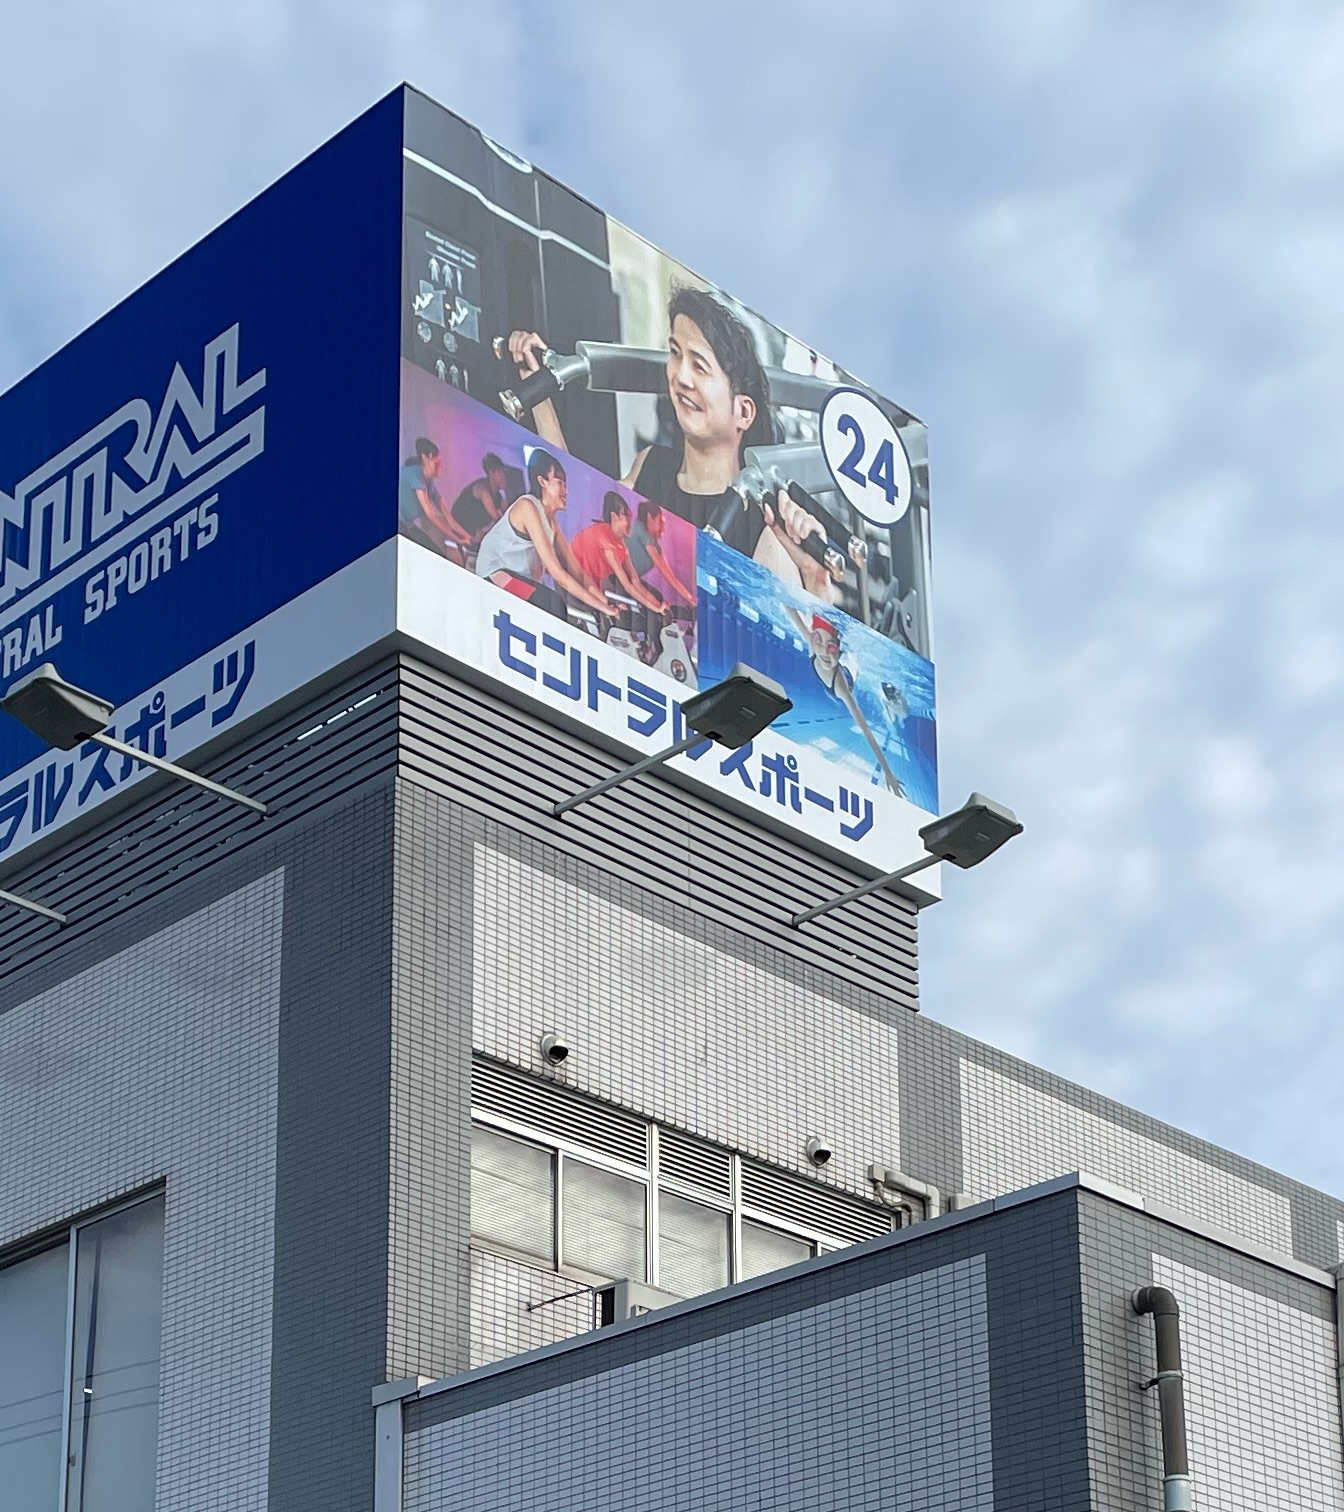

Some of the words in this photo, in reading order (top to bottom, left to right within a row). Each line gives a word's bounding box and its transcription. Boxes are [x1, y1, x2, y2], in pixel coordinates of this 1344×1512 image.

[837, 414, 899, 505] 24
[84, 493, 219, 625] SPORTS
[493, 609, 874, 842] セントラルスポーツ
